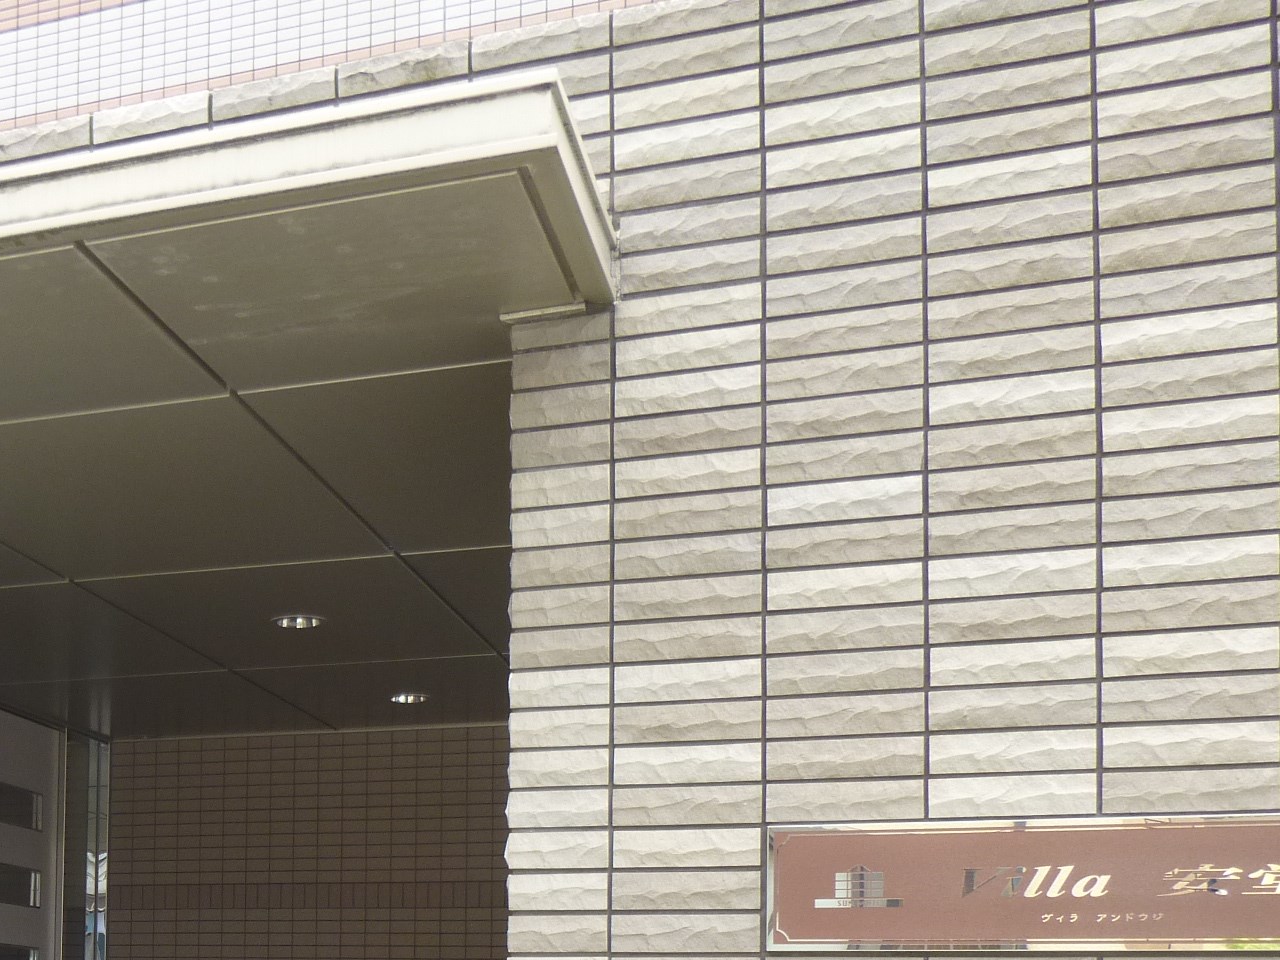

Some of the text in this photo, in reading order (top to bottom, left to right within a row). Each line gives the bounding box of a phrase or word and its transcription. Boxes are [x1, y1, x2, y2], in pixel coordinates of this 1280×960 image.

[961, 865, 1111, 898] Villa
[1041, 912, 1165, 924] ヴィラ アンドウジ
